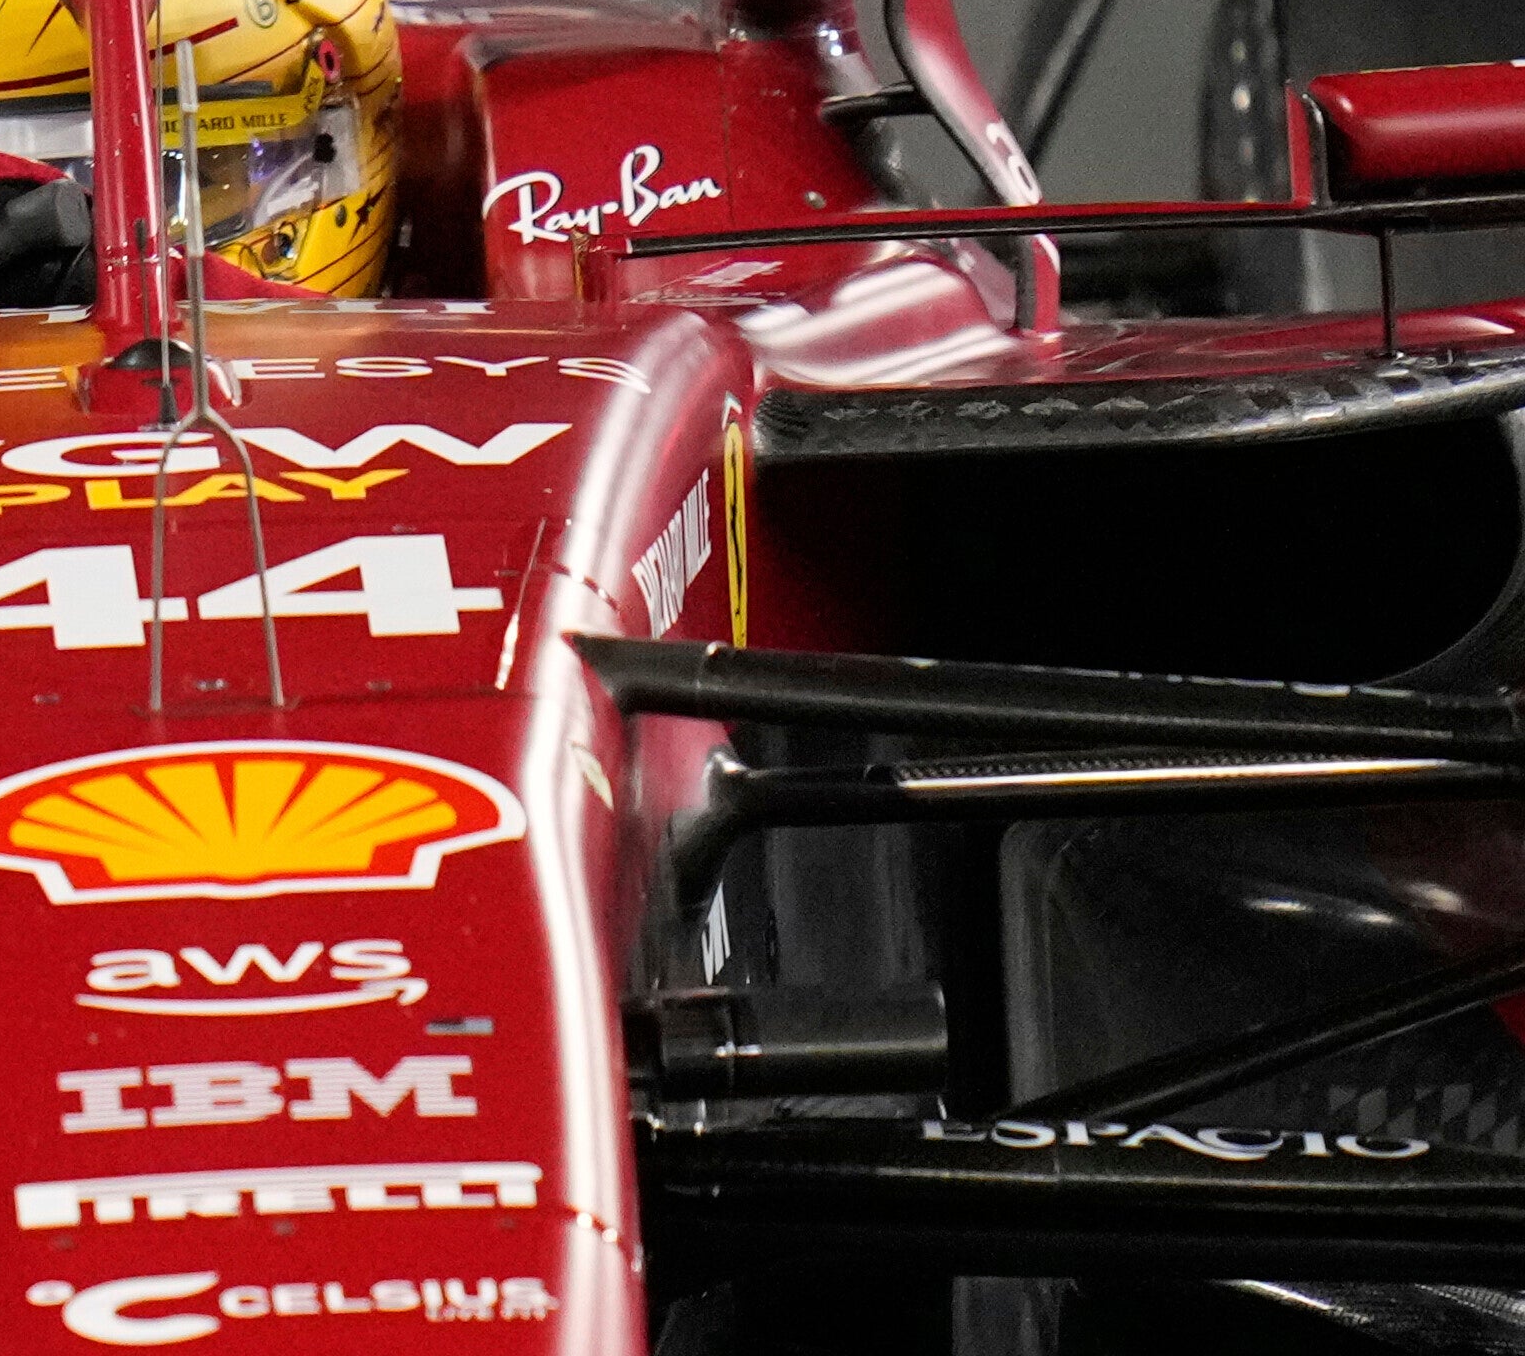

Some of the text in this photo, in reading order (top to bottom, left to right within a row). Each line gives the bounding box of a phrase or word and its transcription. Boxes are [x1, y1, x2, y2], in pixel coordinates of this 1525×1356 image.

[481, 144, 723, 244] Ray-Ban
[85, 938, 411, 991] aws
[57, 1055, 477, 1133] IBM
[15, 1161, 542, 1229] PIRELLI
